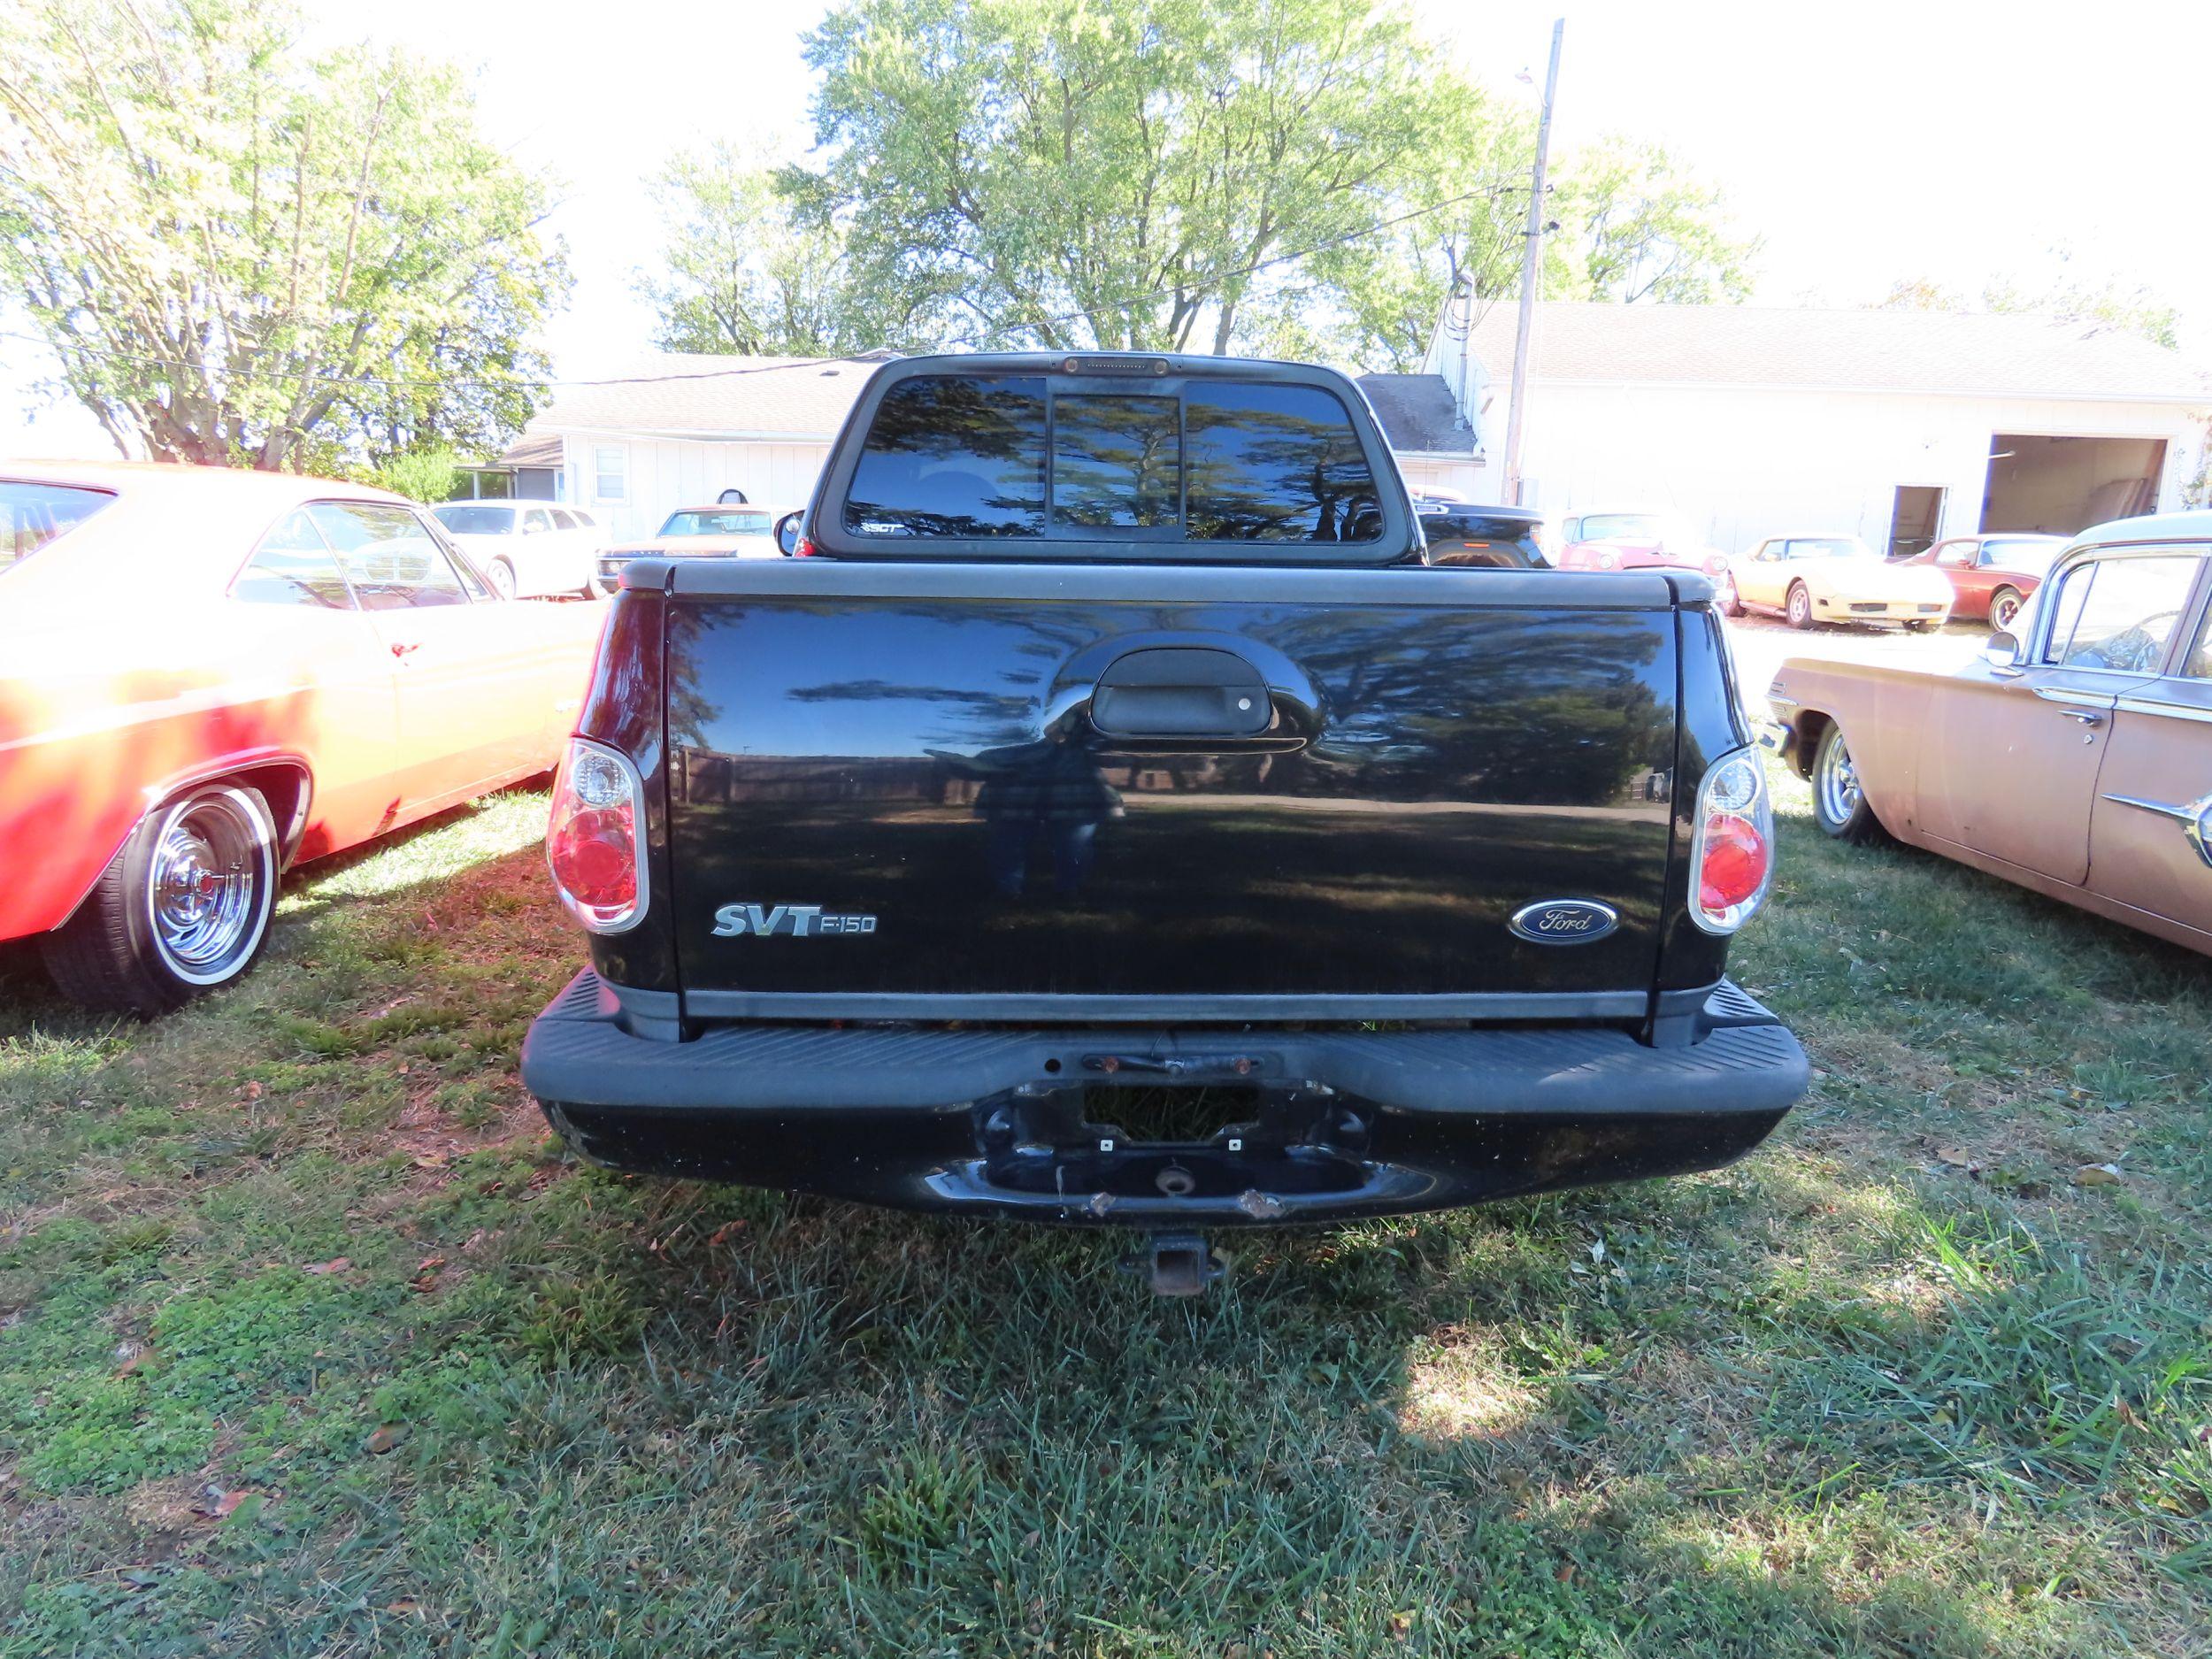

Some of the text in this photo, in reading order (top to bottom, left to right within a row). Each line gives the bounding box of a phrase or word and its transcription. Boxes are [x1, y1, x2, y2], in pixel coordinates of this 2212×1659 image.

[710, 904, 876, 937] SVT F-150
[1539, 909, 1593, 931] Ford
